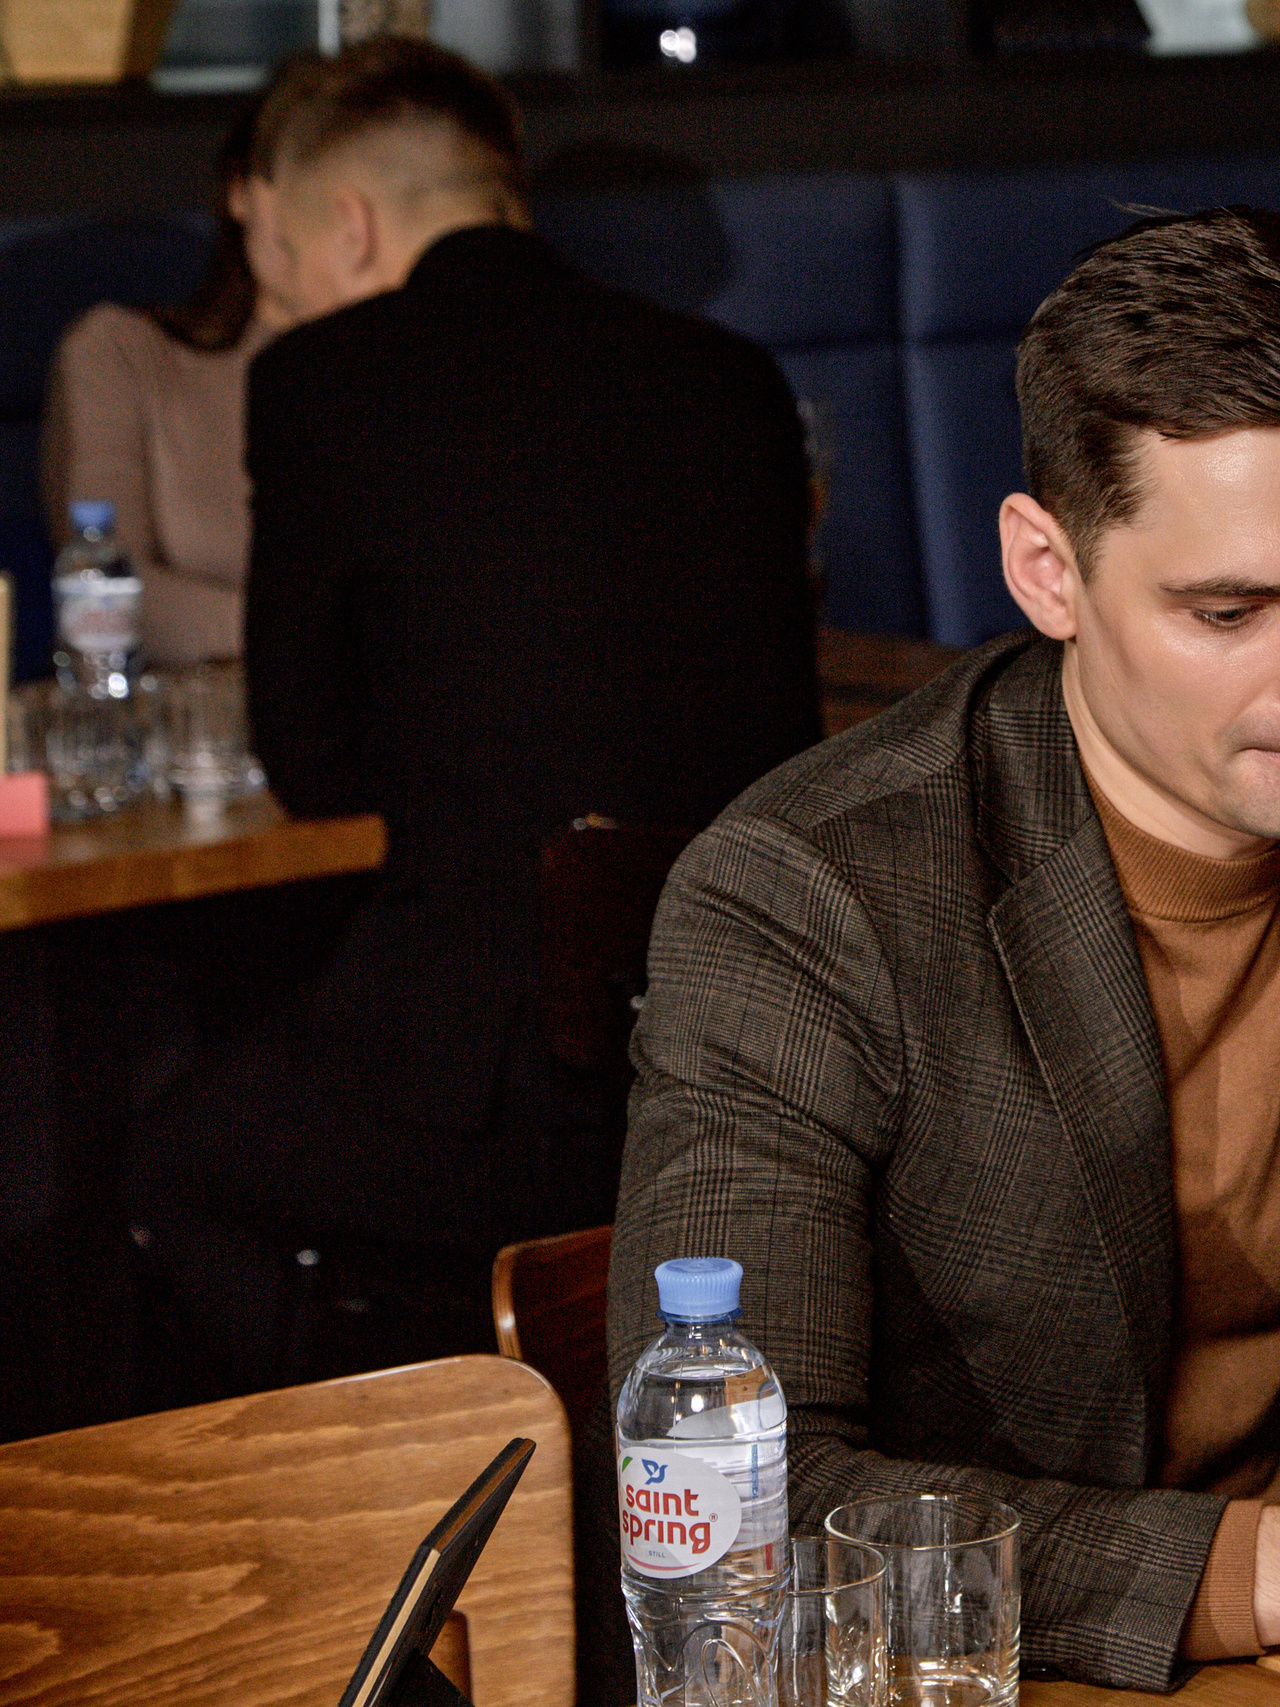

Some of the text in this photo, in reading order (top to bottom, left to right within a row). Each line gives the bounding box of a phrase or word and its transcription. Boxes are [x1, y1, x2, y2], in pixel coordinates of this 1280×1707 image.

[626, 1484, 699, 1516] saint
[622, 1510, 711, 1555] spring
[648, 1550, 666, 1559] STILL
